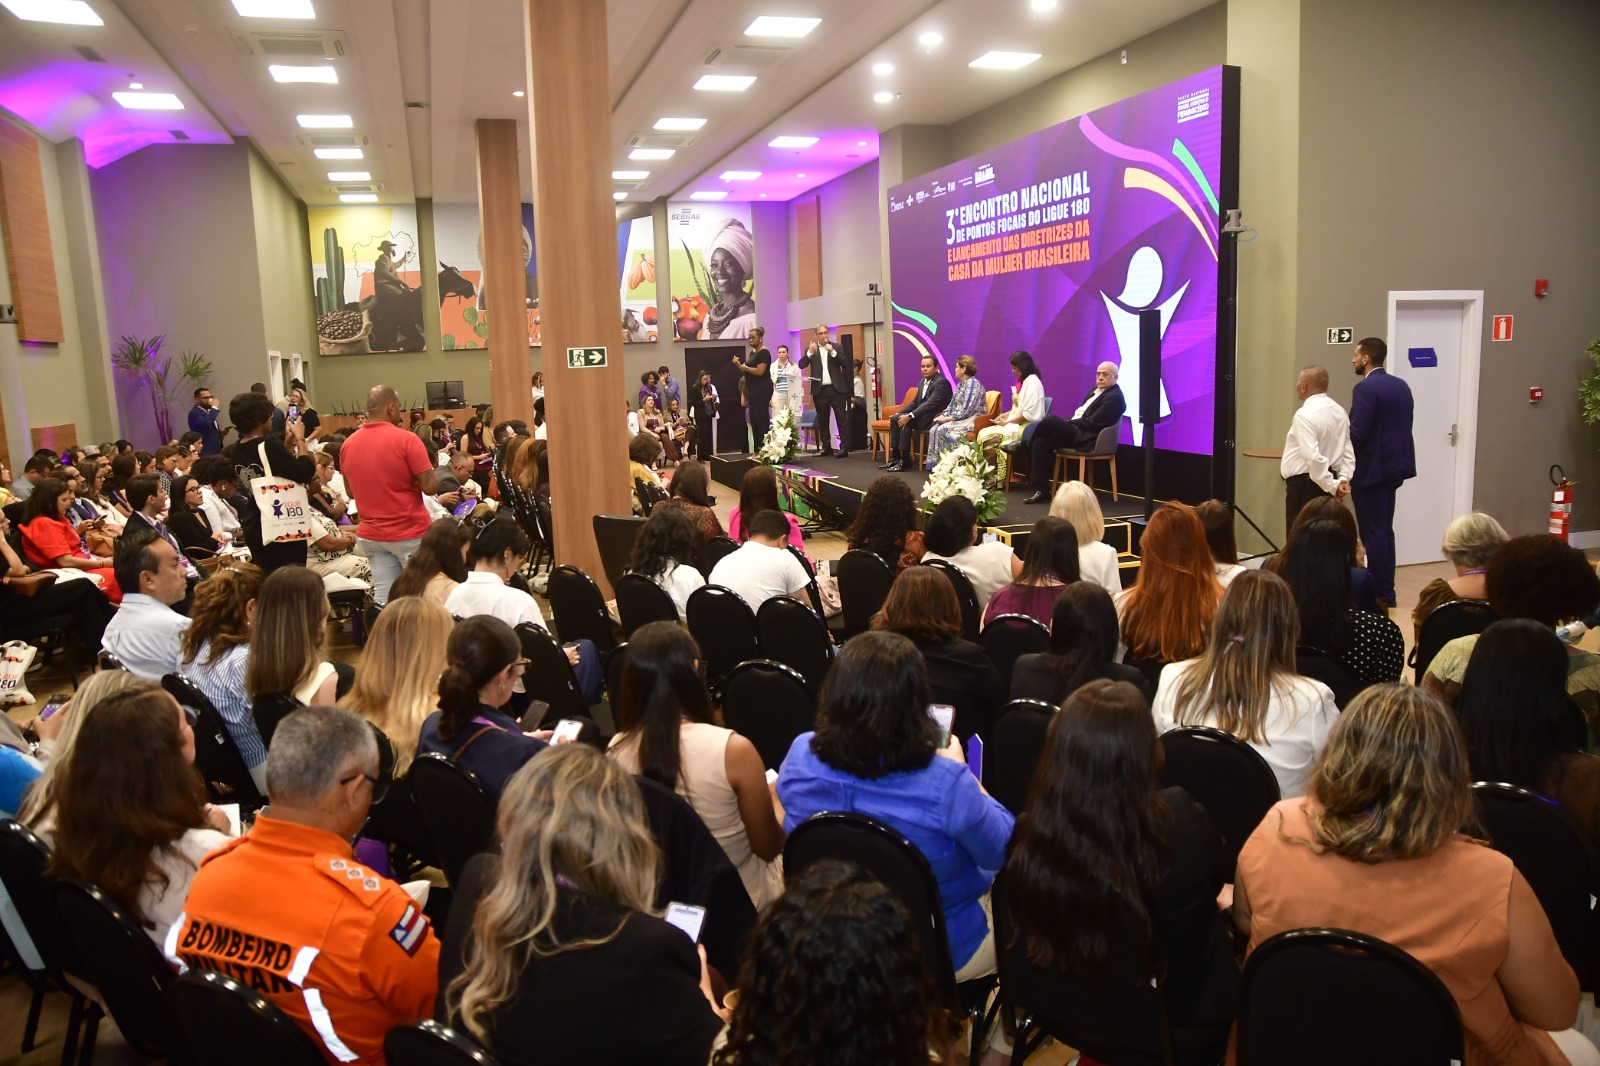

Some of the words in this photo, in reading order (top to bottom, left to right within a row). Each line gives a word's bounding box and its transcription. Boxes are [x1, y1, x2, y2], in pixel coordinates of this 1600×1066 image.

[956, 228, 966, 243] DE
[966, 220, 996, 240] PONTOS
[998, 214, 1027, 234] FOCAIS
[1028, 210, 1040, 227] DO
[1042, 202, 1069, 224] LIGUE
[1071, 198, 1090, 216] 180
[960, 191, 1018, 226] ENCONTRO
[1021, 171, 1090, 210] NACIONAL
[948, 248, 952, 262] E
[953, 238, 1002, 262] LANÇAMENTO
[1003, 234, 1020, 252] DAS
[1021, 222, 1074, 248] DIRETRIZES
[1075, 219, 1090, 238] DA
[948, 263, 970, 281] CASA
[972, 260, 984, 278] DA
[985, 252, 1023, 276] MULHER
[1024, 240, 1090, 270] BRASILEIRA
[286, 506, 303, 517] 180
[182, 920, 292, 971] BOMBEIRO
